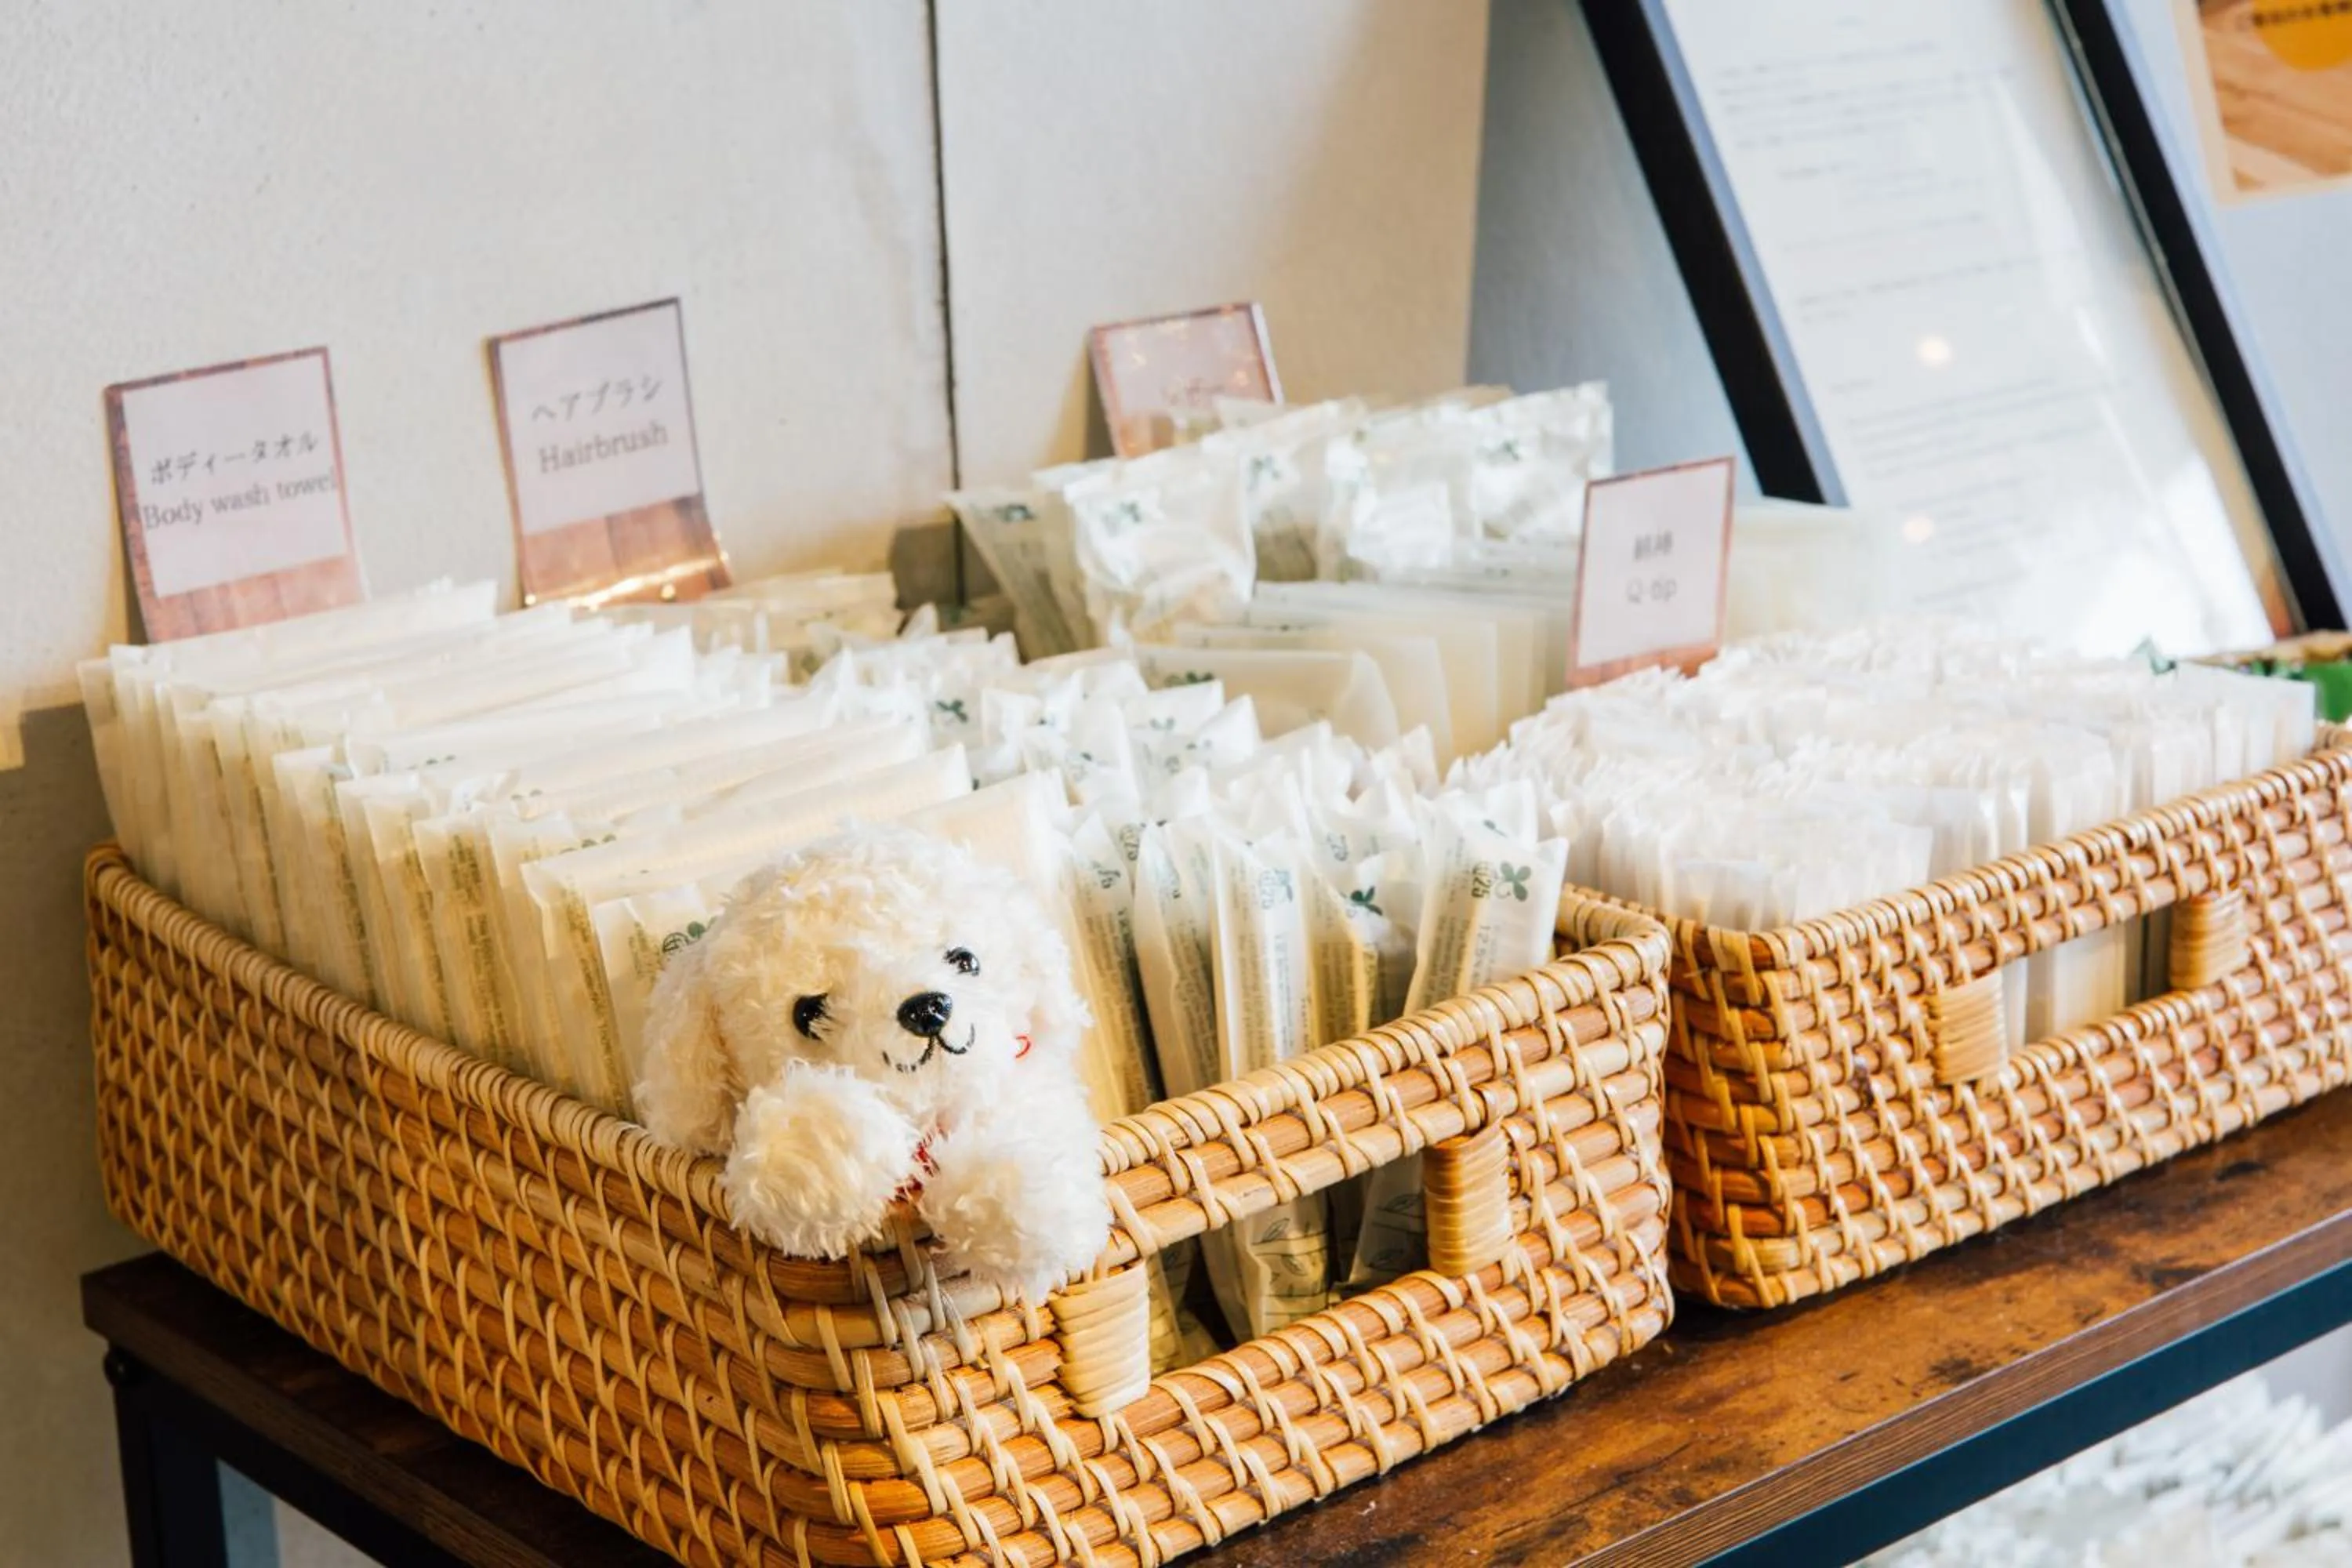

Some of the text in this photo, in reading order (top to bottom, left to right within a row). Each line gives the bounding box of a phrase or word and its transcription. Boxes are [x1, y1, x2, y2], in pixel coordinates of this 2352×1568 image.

[539, 419, 670, 474] Hairbrush
[143, 466, 336, 529] Body wash towel
